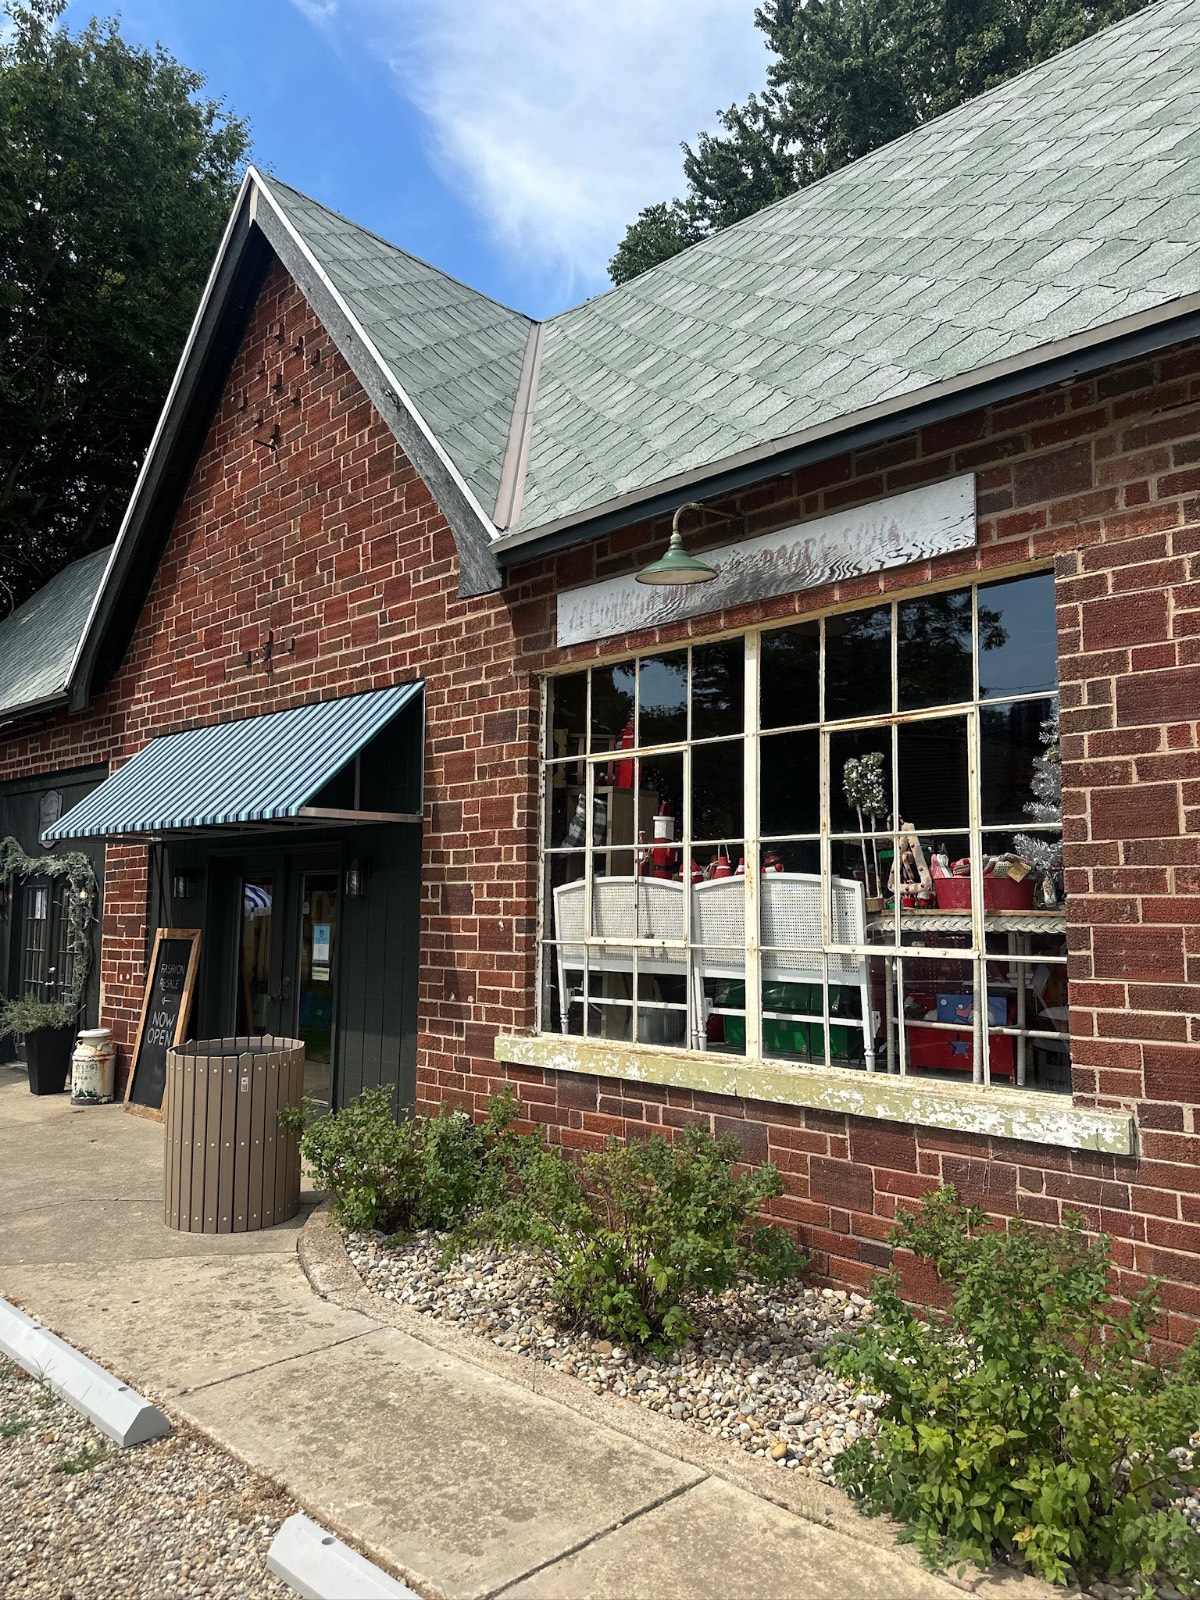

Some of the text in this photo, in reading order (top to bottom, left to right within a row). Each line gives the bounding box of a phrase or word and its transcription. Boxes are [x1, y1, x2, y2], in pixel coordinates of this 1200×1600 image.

[160, 978, 180, 991] RESALE
[152, 1011, 176, 1028] NOW
[147, 1028, 173, 1046] OPEN
